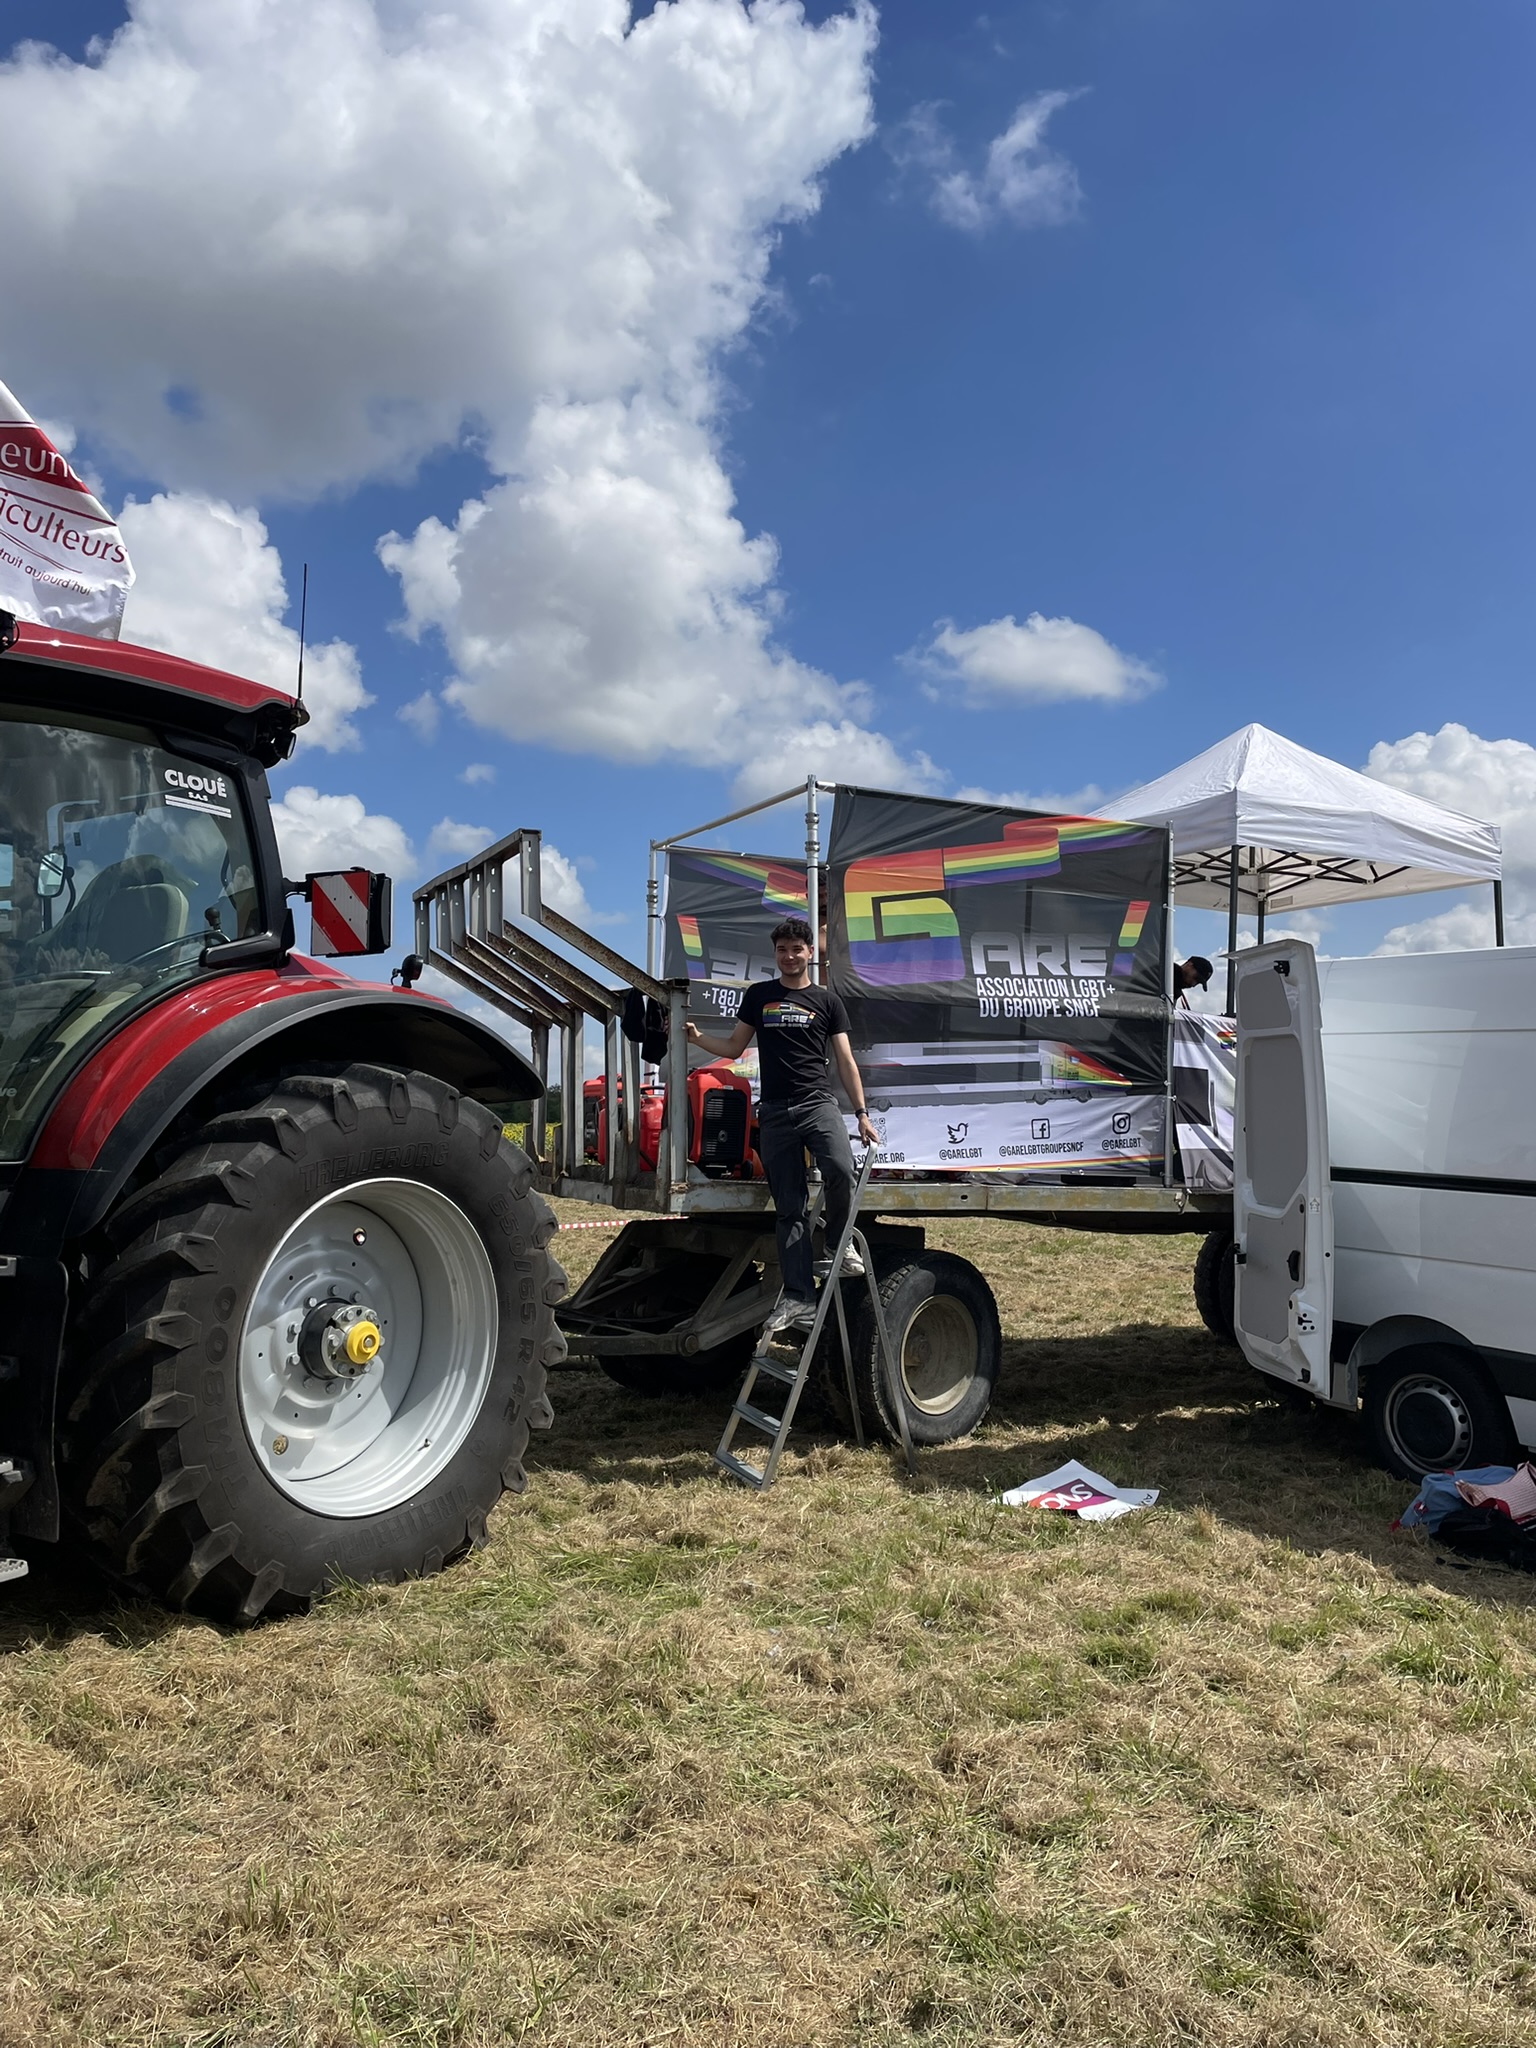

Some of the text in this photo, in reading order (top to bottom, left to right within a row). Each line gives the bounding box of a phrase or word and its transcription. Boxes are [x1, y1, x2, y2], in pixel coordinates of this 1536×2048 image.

[25, 565, 92, 596] aujourd'hui
[164, 769, 227, 798] CLOUÉ
[976, 977, 1116, 998] ASSOCIATION LGBT+
[979, 997, 1101, 1018] DU GROUPE SNCF
[999, 1142, 1084, 1157] @GARELGBTGROUPESNCF
[1102, 1137, 1142, 1150] @GARELGBT
[939, 1148, 983, 1161] @GARELGBT
[301, 1142, 449, 1192] TRELLEBORG
